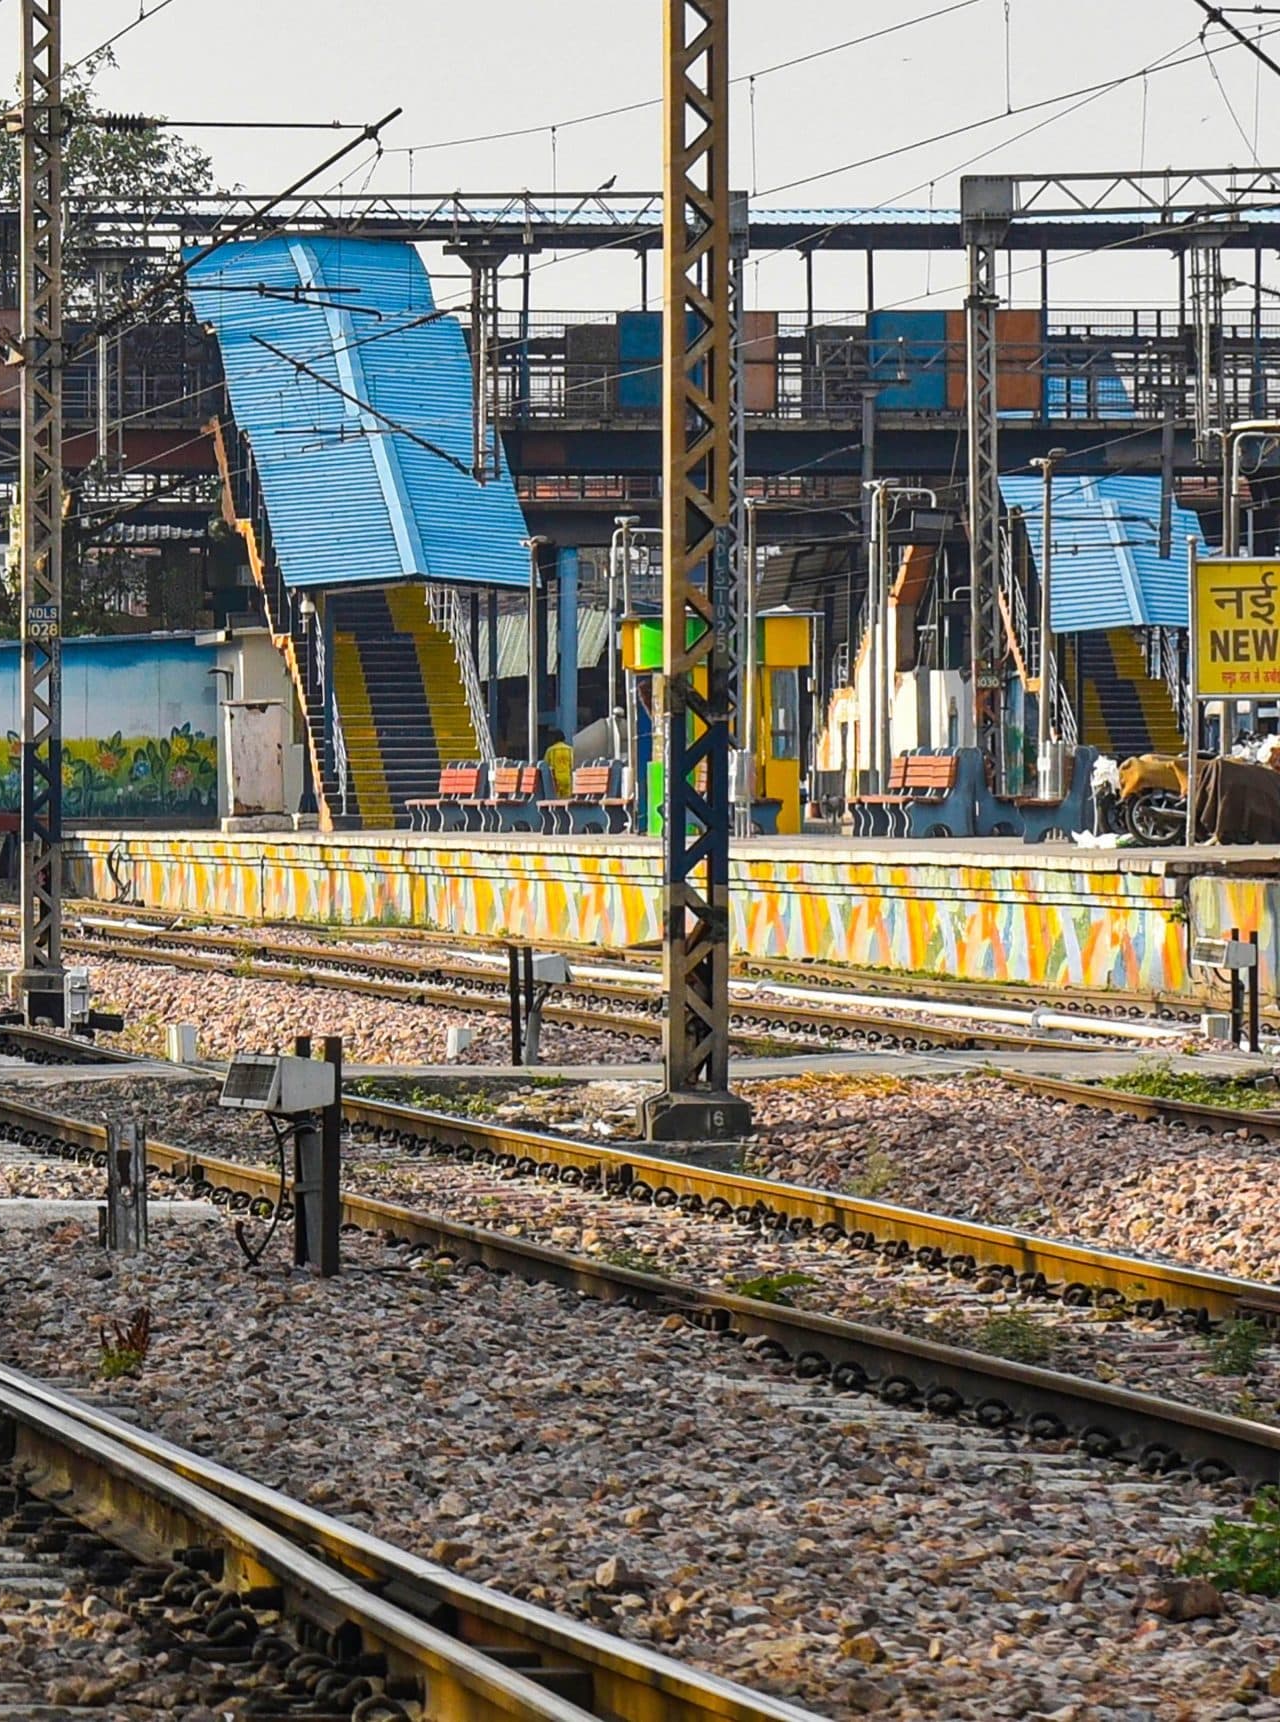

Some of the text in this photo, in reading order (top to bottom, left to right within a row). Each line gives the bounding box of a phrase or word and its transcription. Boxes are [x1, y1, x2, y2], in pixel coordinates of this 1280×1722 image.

[1210, 571, 1277, 625] नई
[28, 607, 57, 619] NDLS
[27, 623, 58, 637] 1028
[1210, 629, 1278, 662] NEW
